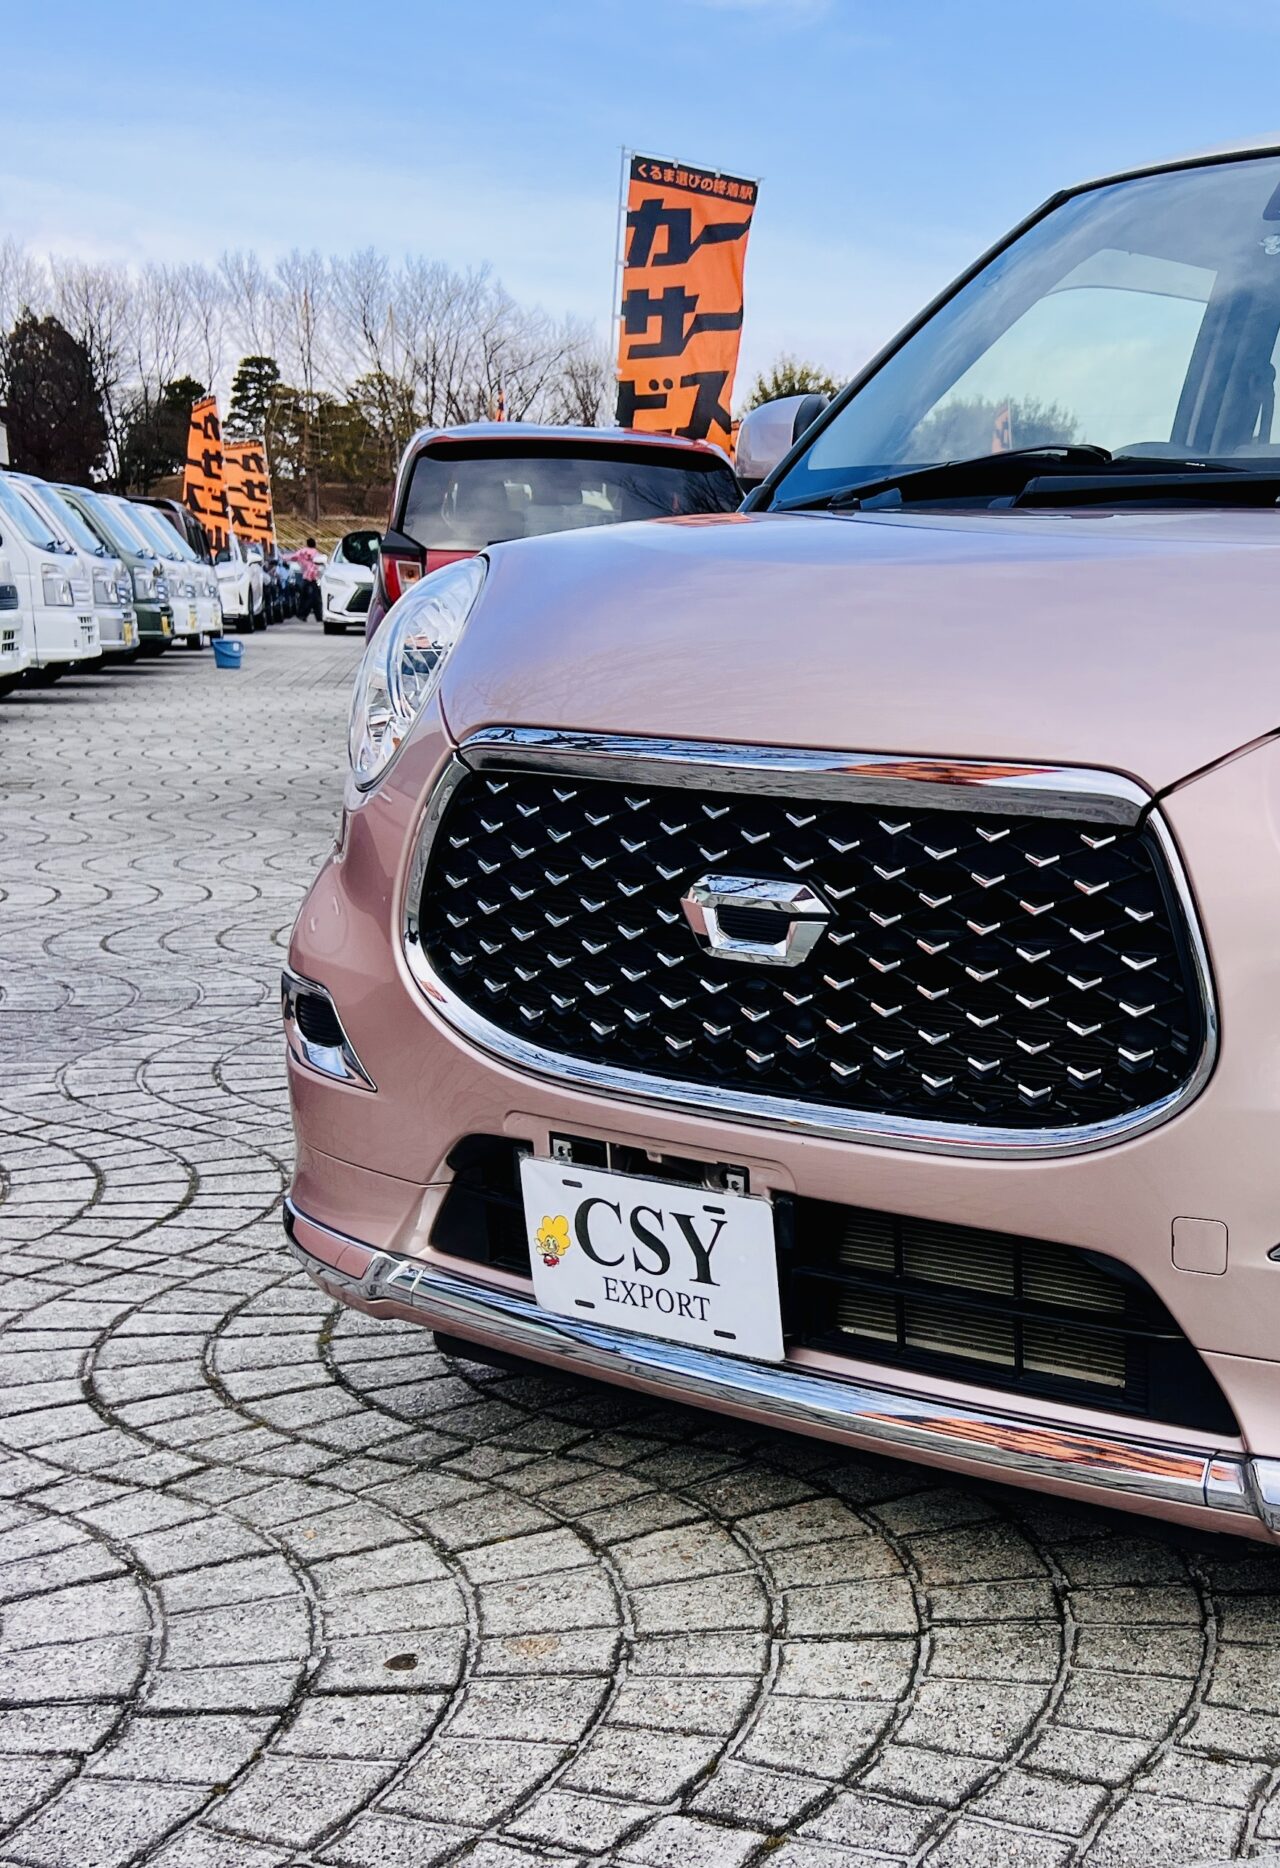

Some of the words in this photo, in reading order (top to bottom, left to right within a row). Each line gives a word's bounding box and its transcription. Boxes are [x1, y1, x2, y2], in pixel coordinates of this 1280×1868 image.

[637, 163, 754, 201] くるま選びの終着駅
[627, 198, 752, 268] カー
[622, 286, 743, 360] サー
[574, 1197, 728, 1287] CSY
[602, 1276, 712, 1322] EXPORT
